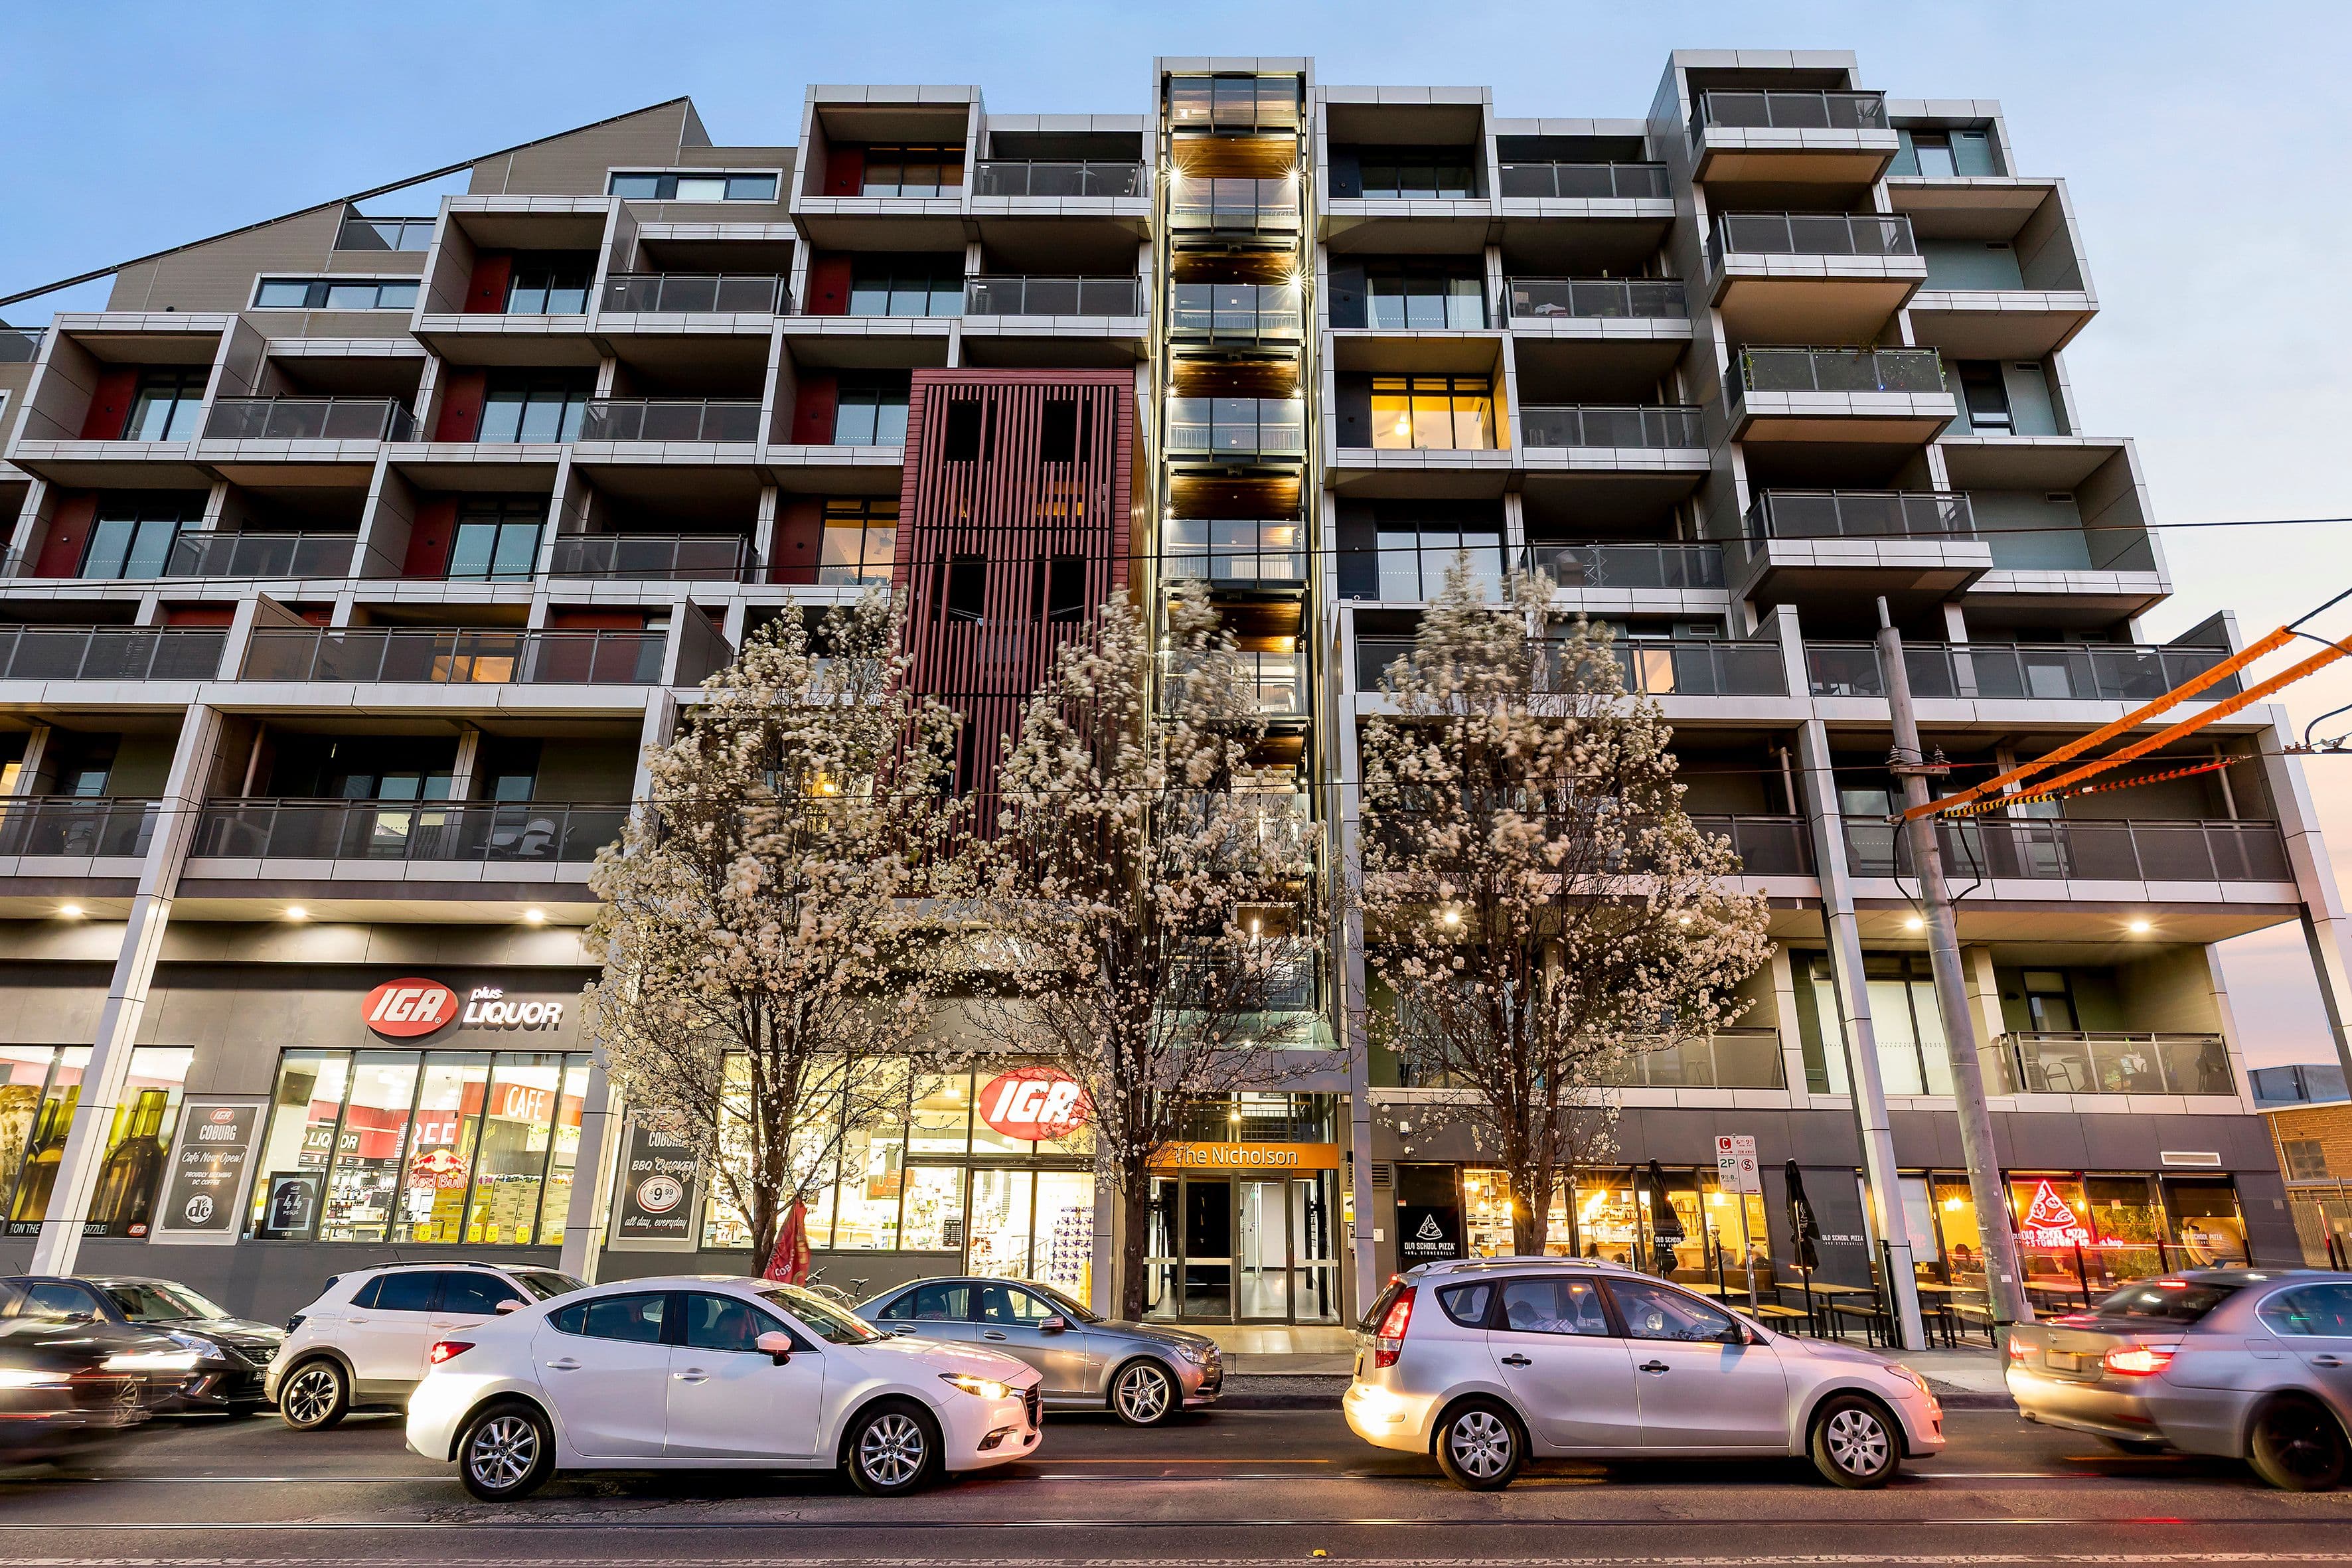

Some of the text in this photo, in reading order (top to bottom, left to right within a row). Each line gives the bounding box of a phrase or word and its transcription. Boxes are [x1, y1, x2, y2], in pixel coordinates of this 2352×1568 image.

[470, 986, 504, 1001] plus
[368, 988, 447, 1022] IGA
[462, 1002, 564, 1024] LIQUOR
[507, 1086, 545, 1121] CAFE
[988, 1081, 1080, 1123] IGA
[213, 1111, 230, 1120] IGA
[199, 1125, 237, 1140] COBURG
[307, 1131, 358, 1150] LIQOR
[182, 1150, 245, 1165] Café Now Open!
[1212, 1146, 1298, 1165] Nicholson
[631, 1160, 653, 1171] BBQ
[1720, 1159, 1735, 1168] 2P
[409, 1174, 466, 1189] Red Bull
[283, 1195, 303, 1210] 44
[13, 1223, 25, 1233] ON
[26, 1223, 40, 1233] THE
[84, 1224, 108, 1234] SIZZLE
[625, 1216, 687, 1229] all day, everyday
